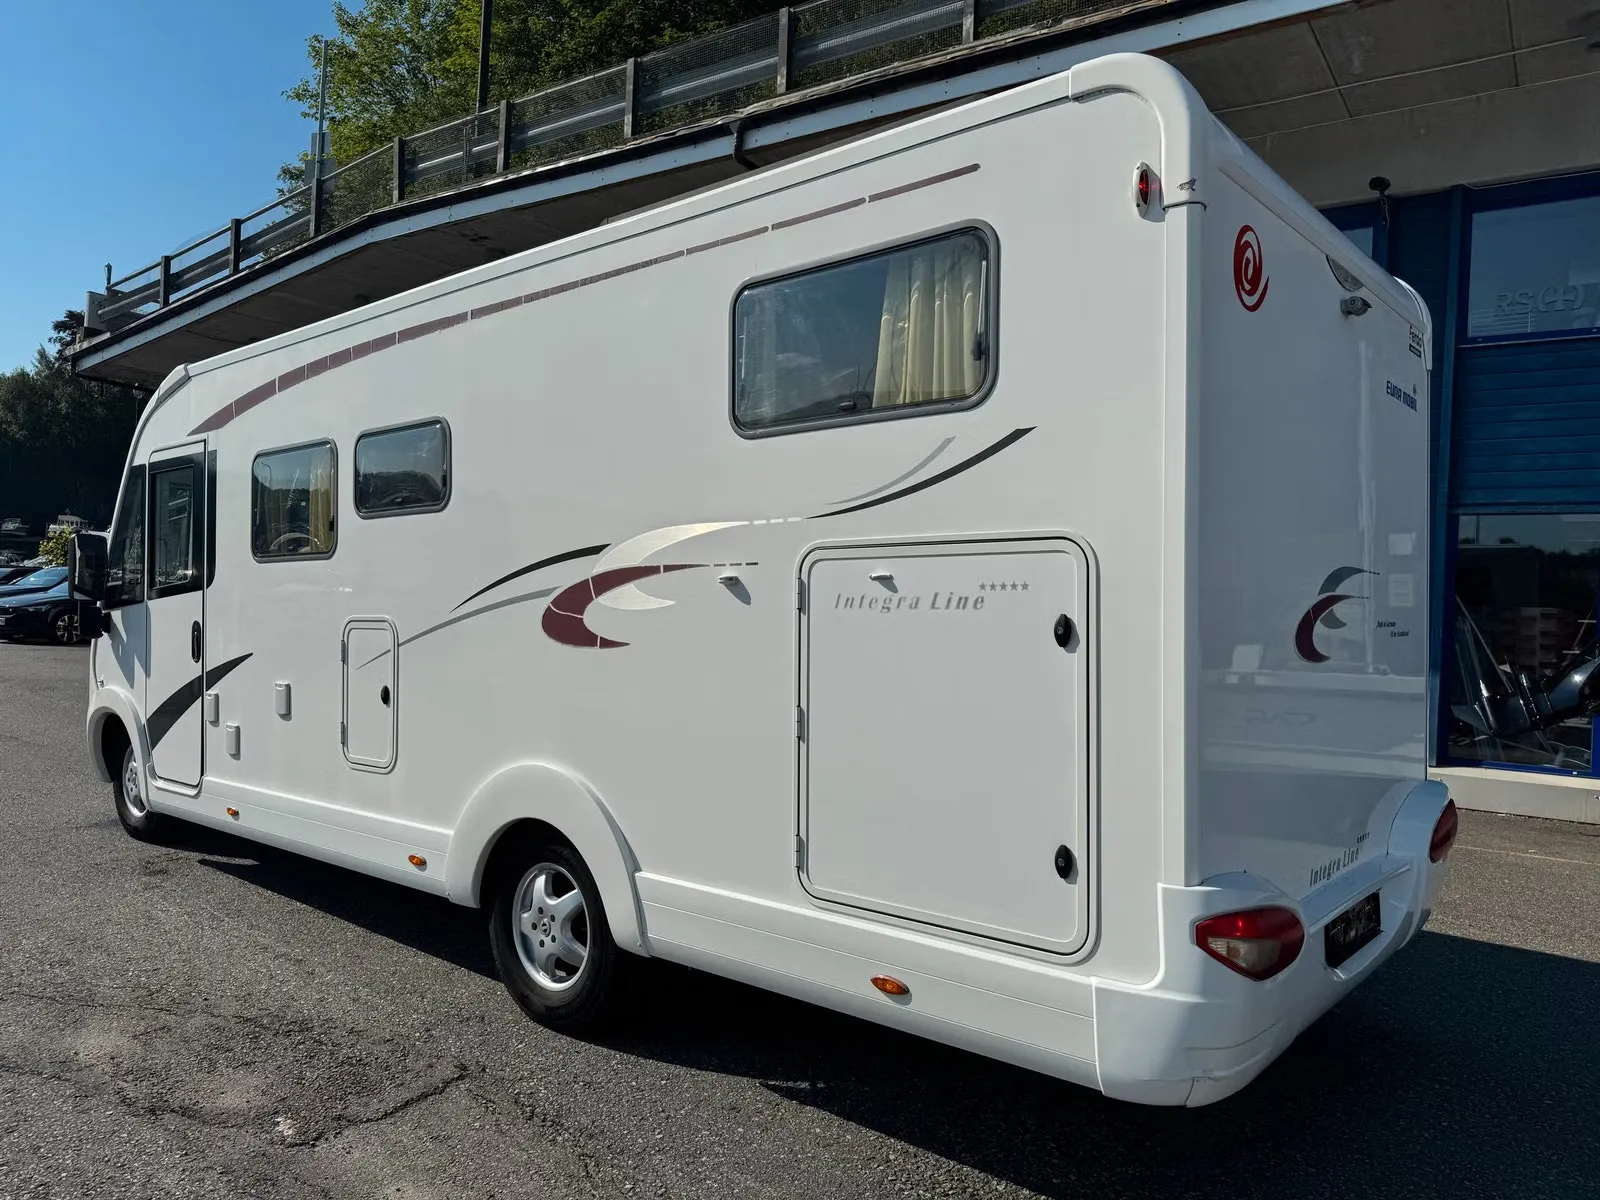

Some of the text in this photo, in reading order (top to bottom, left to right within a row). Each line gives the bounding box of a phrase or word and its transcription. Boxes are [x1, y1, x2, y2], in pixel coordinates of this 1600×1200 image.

[834, 591, 985, 613] Integra Line
[1309, 847, 1359, 887] Integra Line
